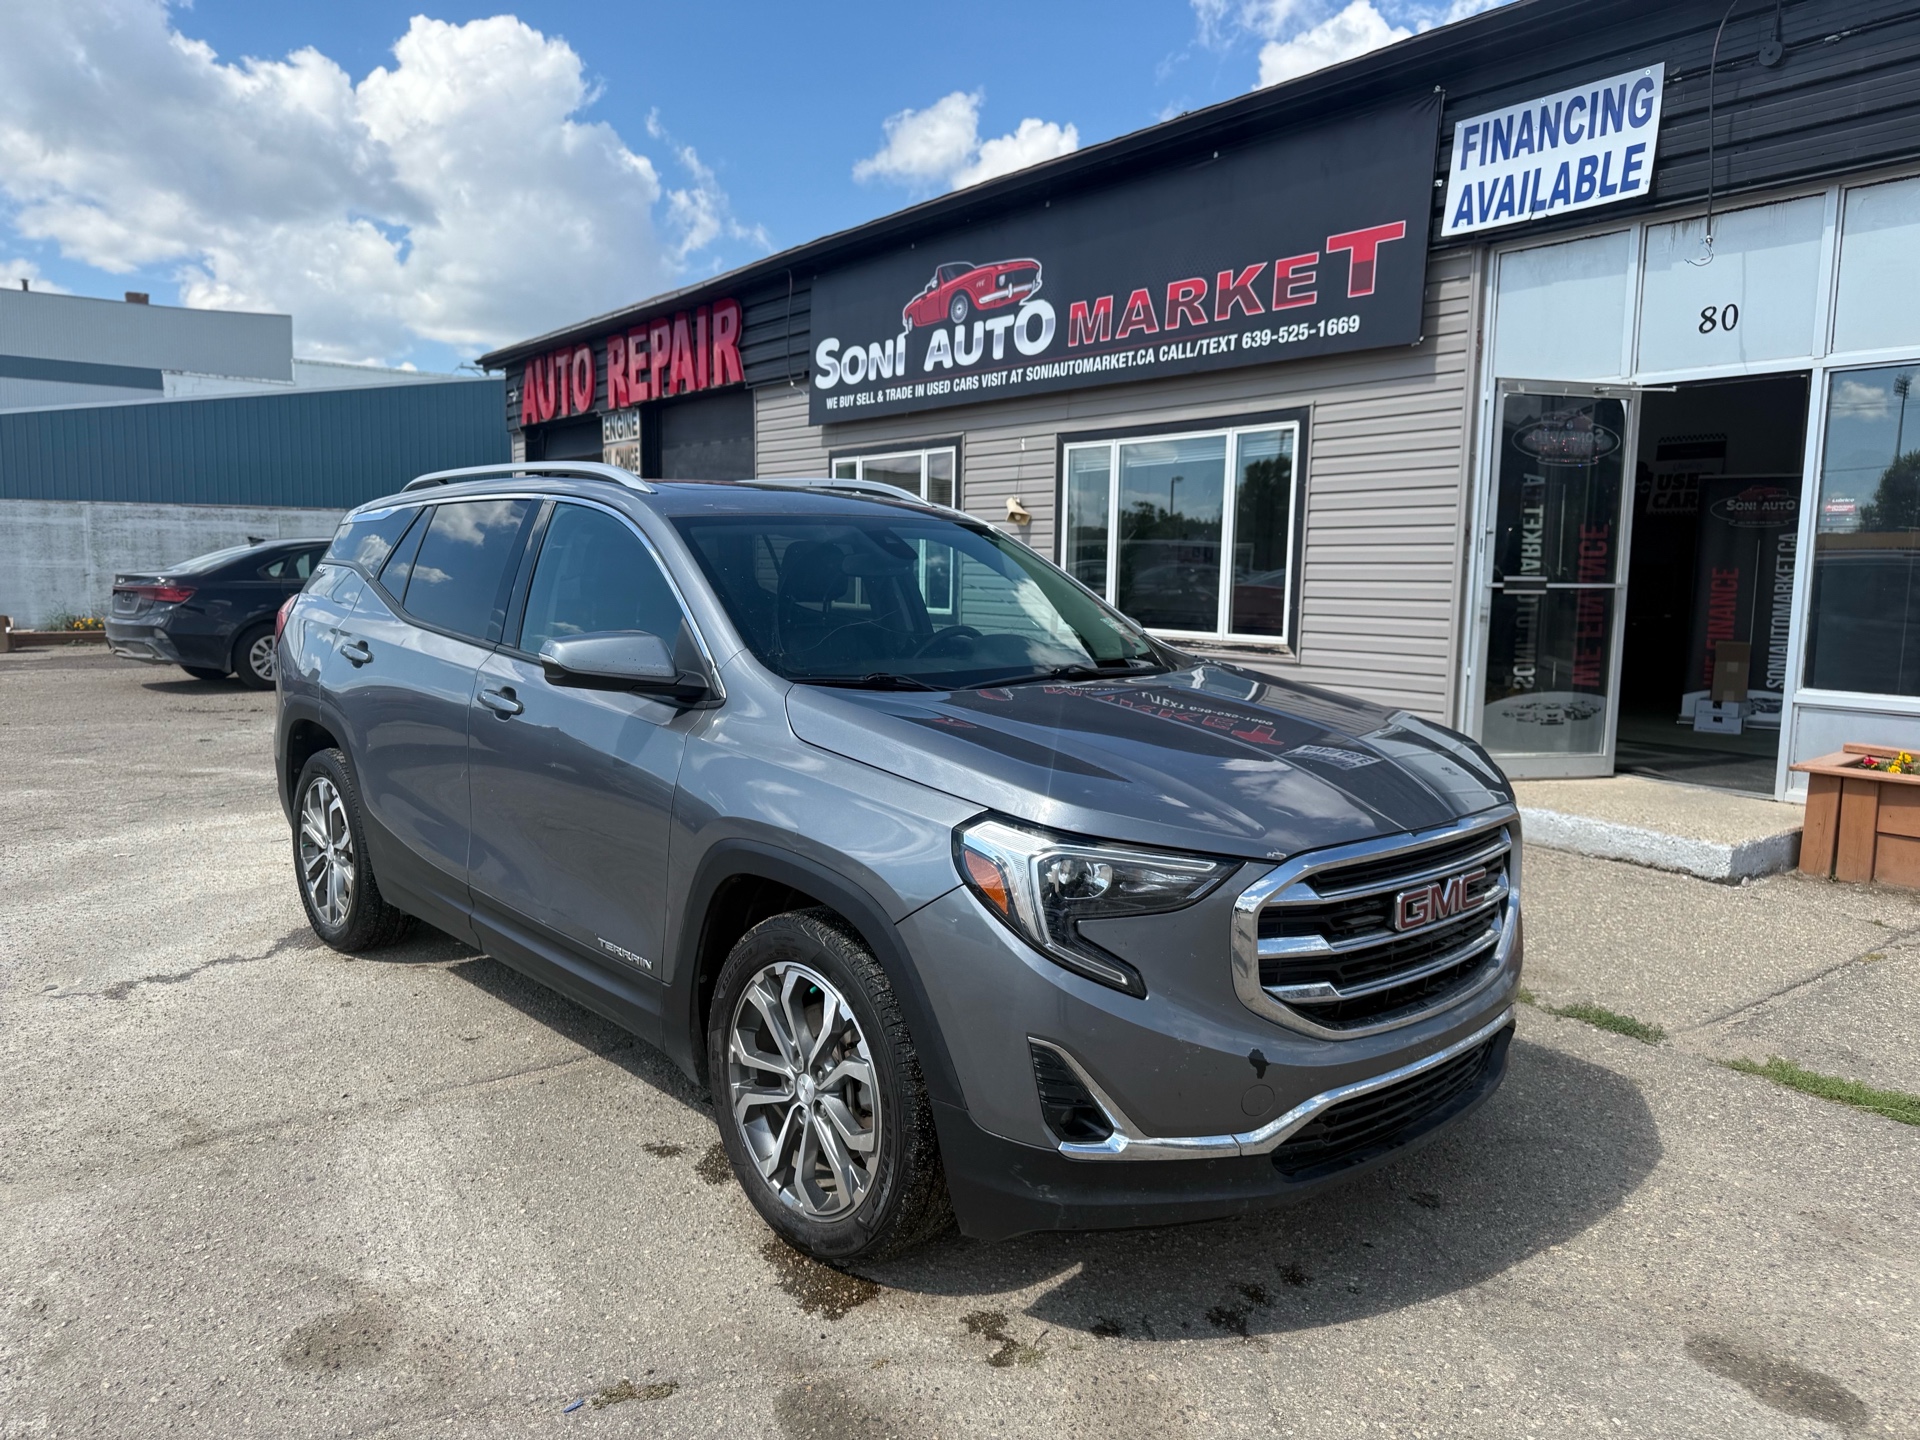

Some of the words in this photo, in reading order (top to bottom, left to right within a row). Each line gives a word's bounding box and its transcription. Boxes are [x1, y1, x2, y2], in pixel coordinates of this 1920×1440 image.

[1460, 76, 1655, 171] FINANCING
[1451, 142, 1647, 228] AVAILABLE
[814, 335, 906, 390] SONI
[923, 300, 1056, 372] AUTO
[1068, 220, 1406, 347] MARKET
[1698, 303, 1739, 334] 80
[521, 343, 596, 426] AUTO
[607, 297, 745, 410] REPAIR
[826, 397, 838, 410] WE
[839, 394, 855, 408] BUY
[856, 391, 875, 406] SELL
[877, 390, 884, 403] &
[885, 385, 913, 402] TRADE
[915, 383, 925, 398] IN
[927, 381, 951, 396] USED
[953, 377, 979, 393] CARS
[981, 371, 1008, 388] VISIT
[1010, 368, 1024, 385] AT
[1026, 349, 1155, 382] SONIAUTOMARKET.CA
[1158, 333, 1238, 362] CALL/TEXT
[1241, 315, 1361, 349] 639-525-1669
[604, 411, 638, 441] ENGINE
[1652, 492, 1698, 509] CAR
[1657, 472, 1711, 490] USE
[1726, 499, 1756, 511] SONI
[1762, 499, 1796, 511] AUTO
[1395, 866, 1486, 932] GMC
[597, 937, 653, 971] TERRAIN
